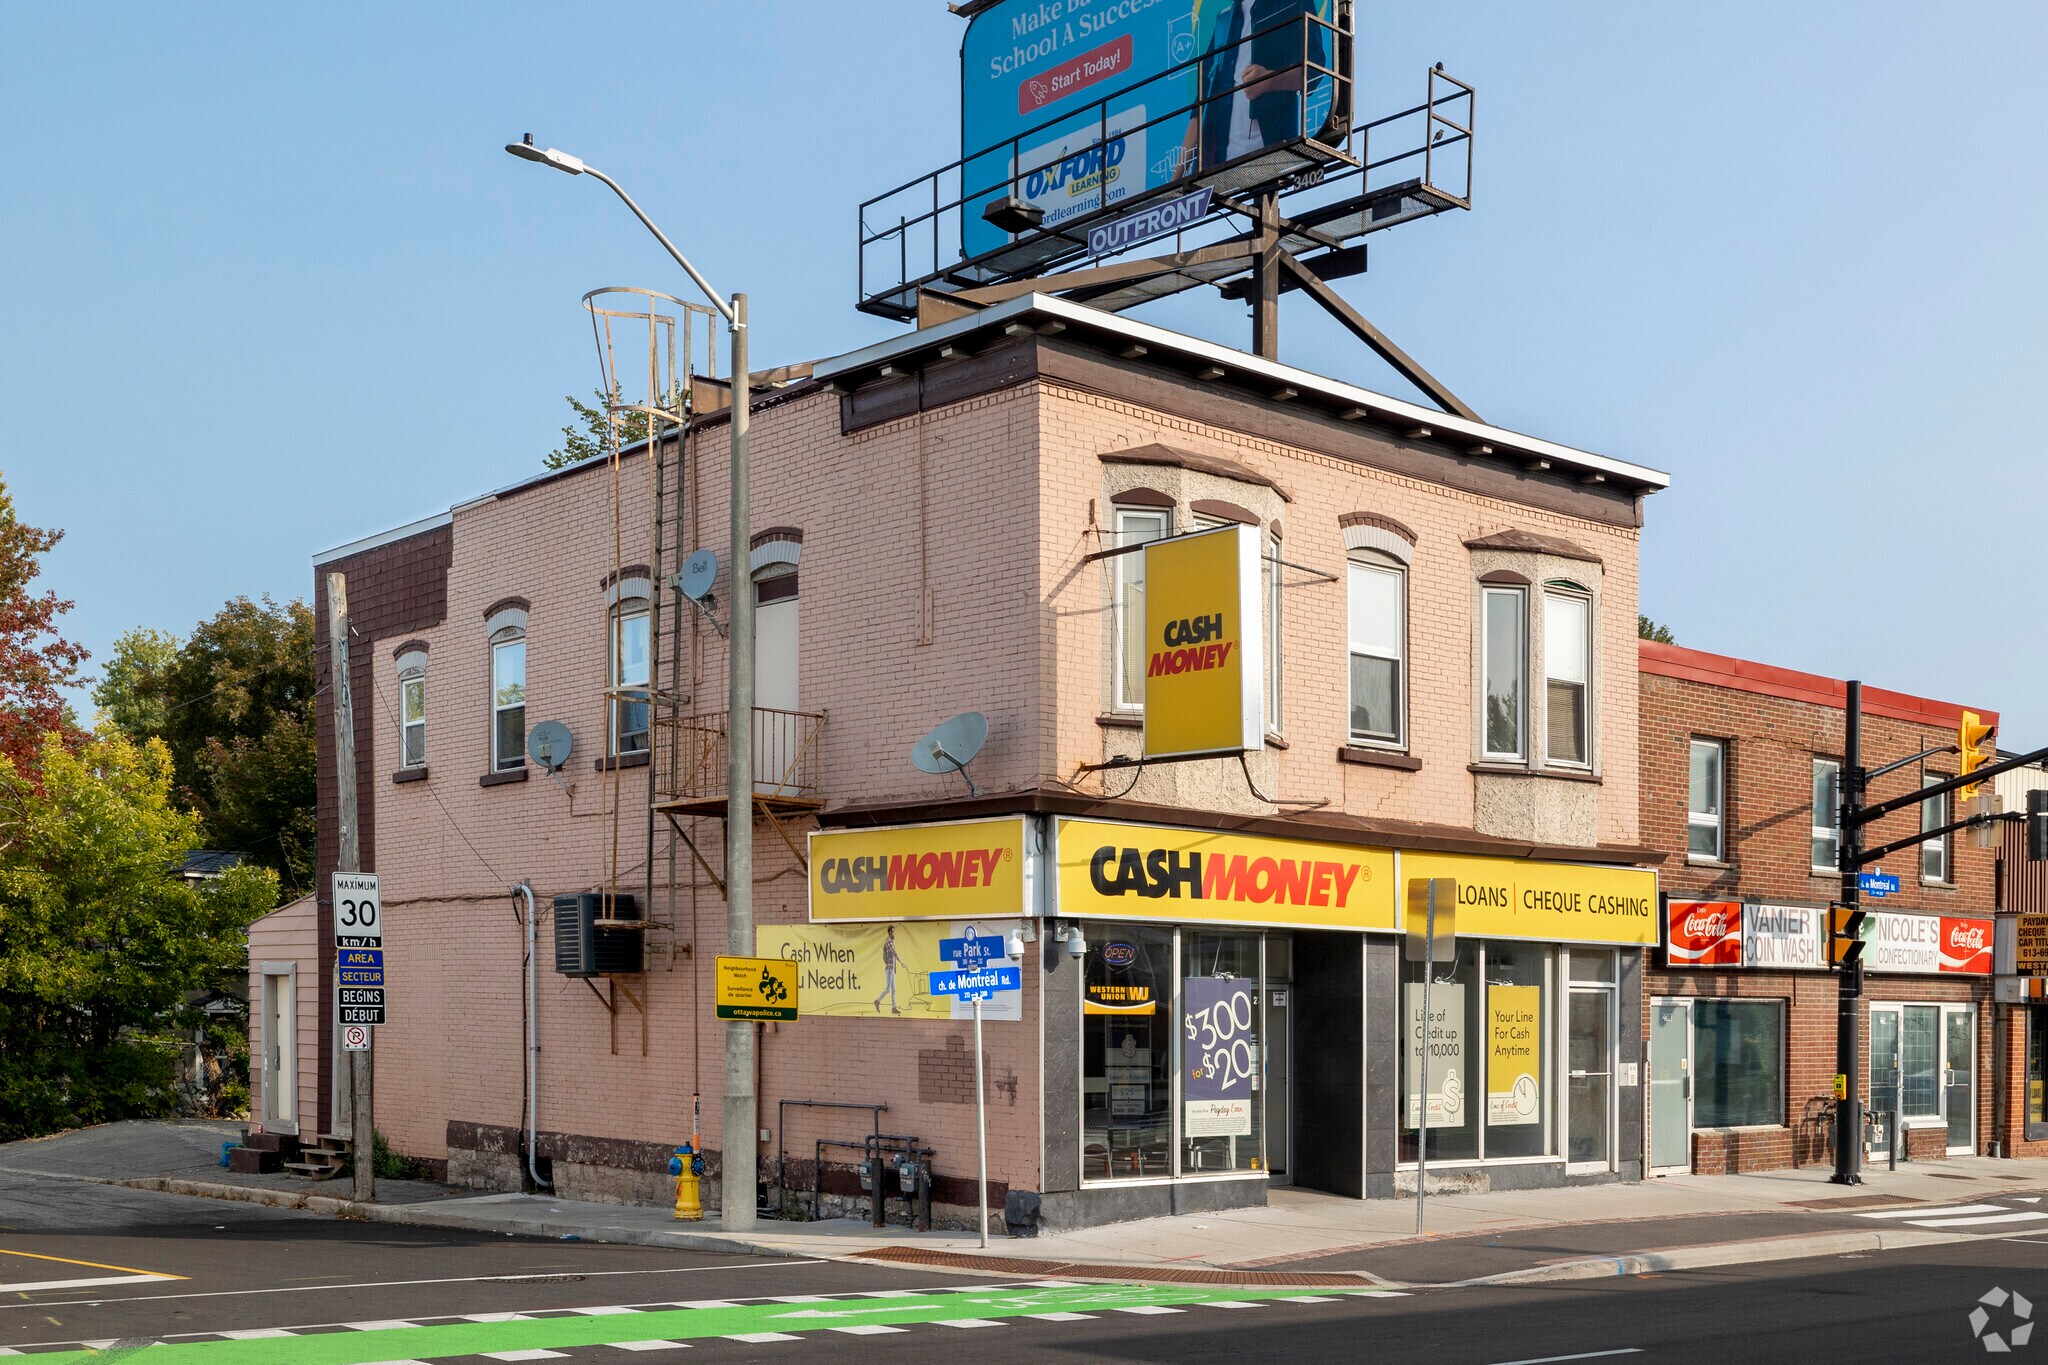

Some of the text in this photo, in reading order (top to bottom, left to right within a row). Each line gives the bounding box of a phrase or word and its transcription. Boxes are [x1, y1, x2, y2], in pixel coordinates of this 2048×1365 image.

[1012, 0, 1063, 40] Make
[990, 0, 1164, 79] School A Succes
[1051, 49, 1120, 92] Start Today!
[1026, 138, 1125, 199] OXFORD
[1293, 169, 1324, 191] 3402
[1092, 193, 1205, 252] OUTFRONT
[692, 559, 708, 574] Bell
[1164, 613, 1222, 647] CASH
[1148, 641, 1233, 678] MONEY
[337, 879, 376, 891] MAXIMUM
[1458, 884, 1507, 907] LOANS
[1523, 889, 1648, 917] CHEQUE CASHING
[340, 899, 376, 927] 30
[1696, 906, 1707, 914] Enjoy
[1749, 906, 1811, 934] VANIER
[1960, 921, 1968, 930] Enjoy
[1878, 917, 1938, 944] NICOLE'S
[2018, 928, 2046, 937] CHEQUE
[342, 937, 376, 947] km/h
[963, 941, 982, 957] Park
[1745, 936, 1815, 963] COIN WASH
[2018, 938, 2033, 946] CAR
[348, 954, 374, 964] AREA
[781, 942, 855, 962] Cash When
[1104, 948, 1134, 959] OPEN
[1878, 948, 1938, 966] CONFECTIONARY
[342, 971, 381, 982] SECTEUR
[808, 969, 844, 989] Need
[848, 970, 861, 990] It.
[938, 970, 1011, 991] ch. de Montréal Rd.
[342, 990, 380, 1003] BEGINS
[1127, 986, 1149, 1001] WU
[345, 1007, 379, 1022] DÉBUT
[733, 1009, 781, 1017] ottawapolice.ca
[1185, 991, 1251, 1050] $300
[1415, 1008, 1446, 1021] Lie of
[1494, 1010, 1533, 1023] Your Line
[1415, 1026, 1457, 1042] Cedit up
[1494, 1027, 1529, 1039] For Cash
[1428, 1043, 1459, 1058] 10,000
[1494, 1044, 1530, 1059] Anytime
[1192, 1068, 1204, 1080] for
[1202, 1039, 1251, 1091] $20
[1210, 1104, 1229, 1117] Payday
[1231, 1102, 1243, 1113] Loan
